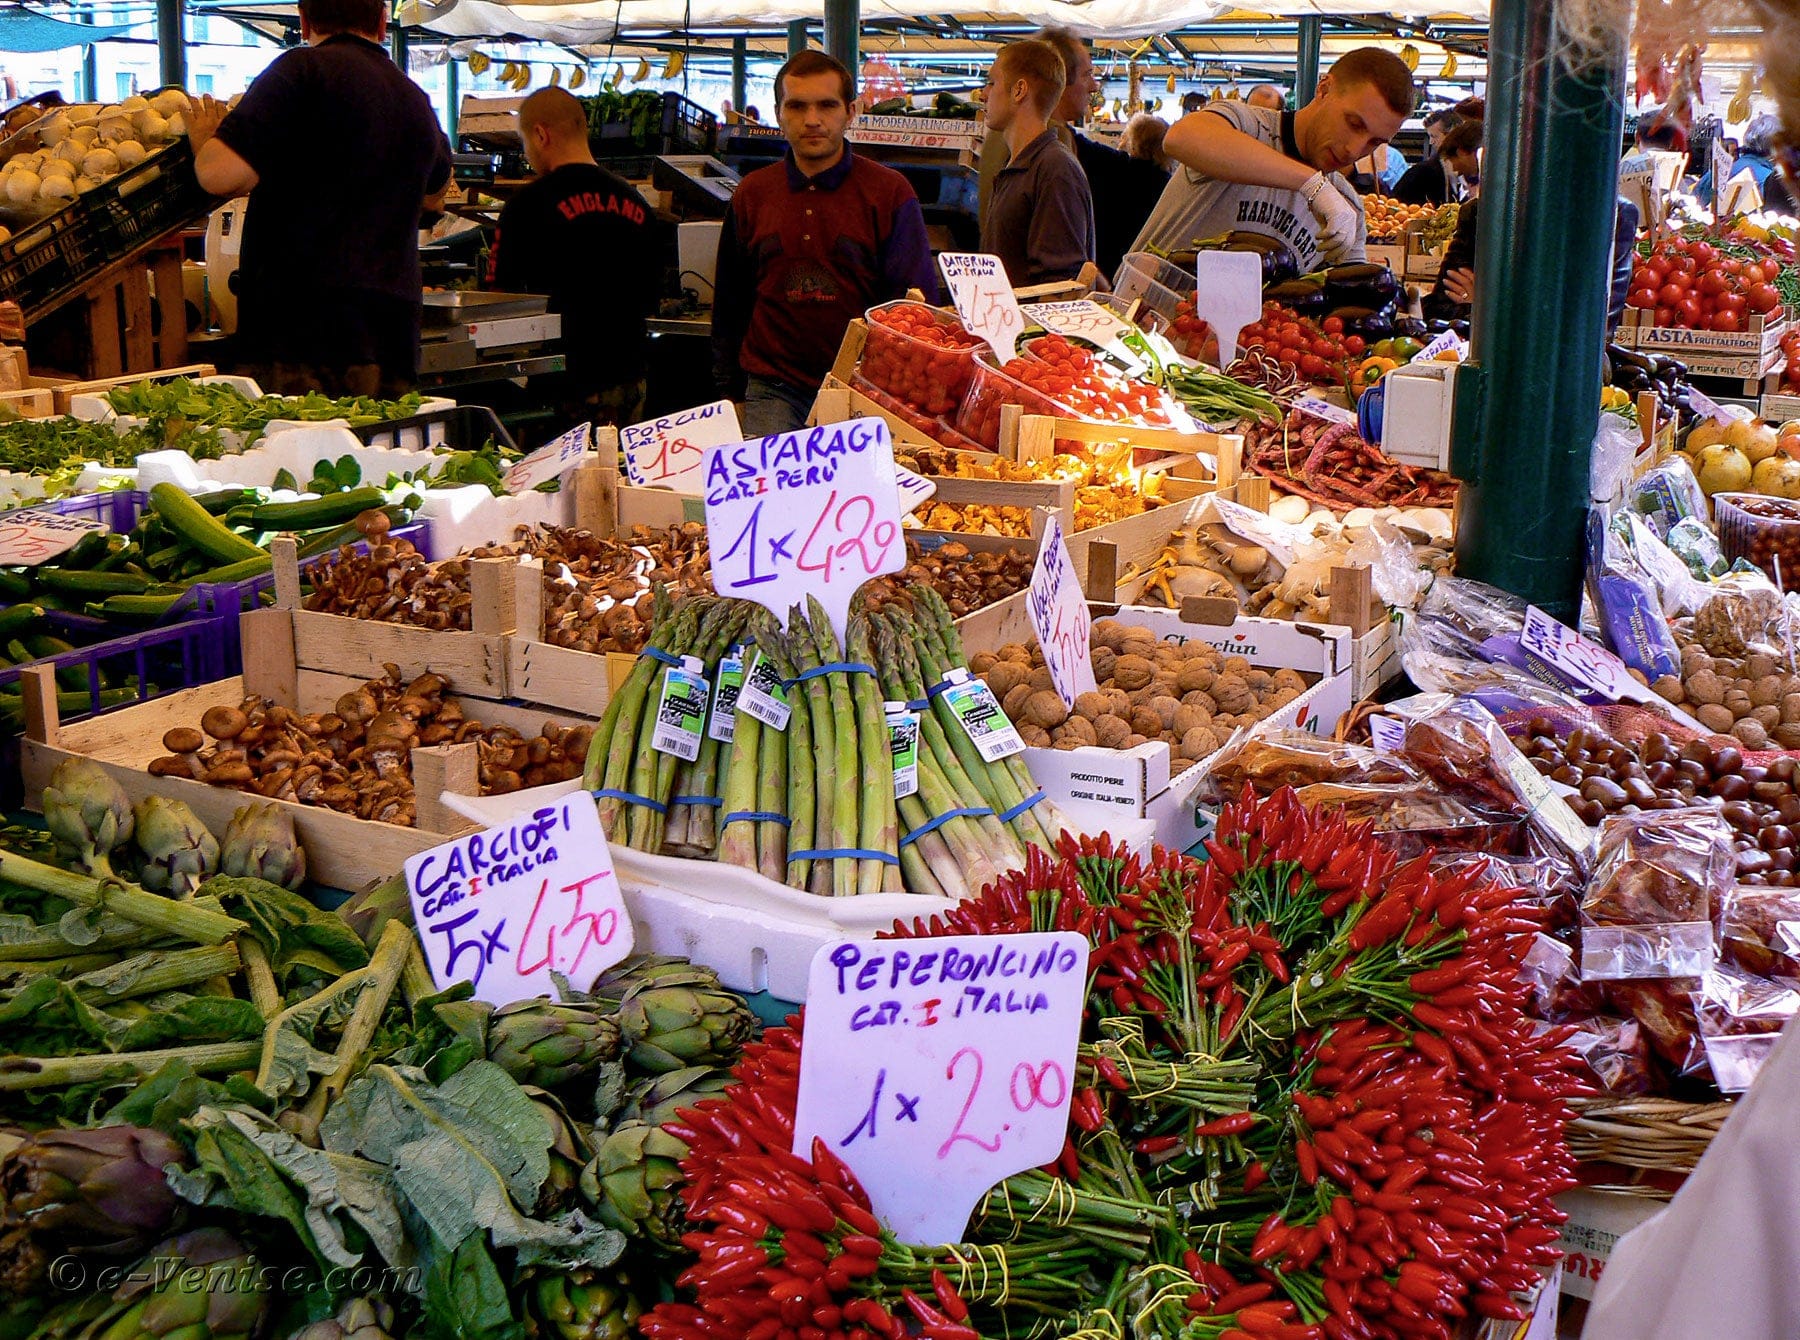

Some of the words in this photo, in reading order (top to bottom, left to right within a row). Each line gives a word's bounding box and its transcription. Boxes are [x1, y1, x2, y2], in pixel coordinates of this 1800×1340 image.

[871, 116, 918, 129] MODENA
[557, 192, 645, 225] ENGLAND
[1646, 329, 1695, 344] ASTA
[706, 423, 883, 489] ASPARAGI
[1070, 772, 1103, 784] PRODOTTO
[415, 804, 571, 898] CARCIOFI
[487, 846, 560, 887] ITALIA
[829, 941, 1078, 995] PEPERONCINO
[912, 998, 942, 1028] I
[953, 985, 1050, 1018] ITALIA
[936, 1046, 1067, 1160] 2.00
